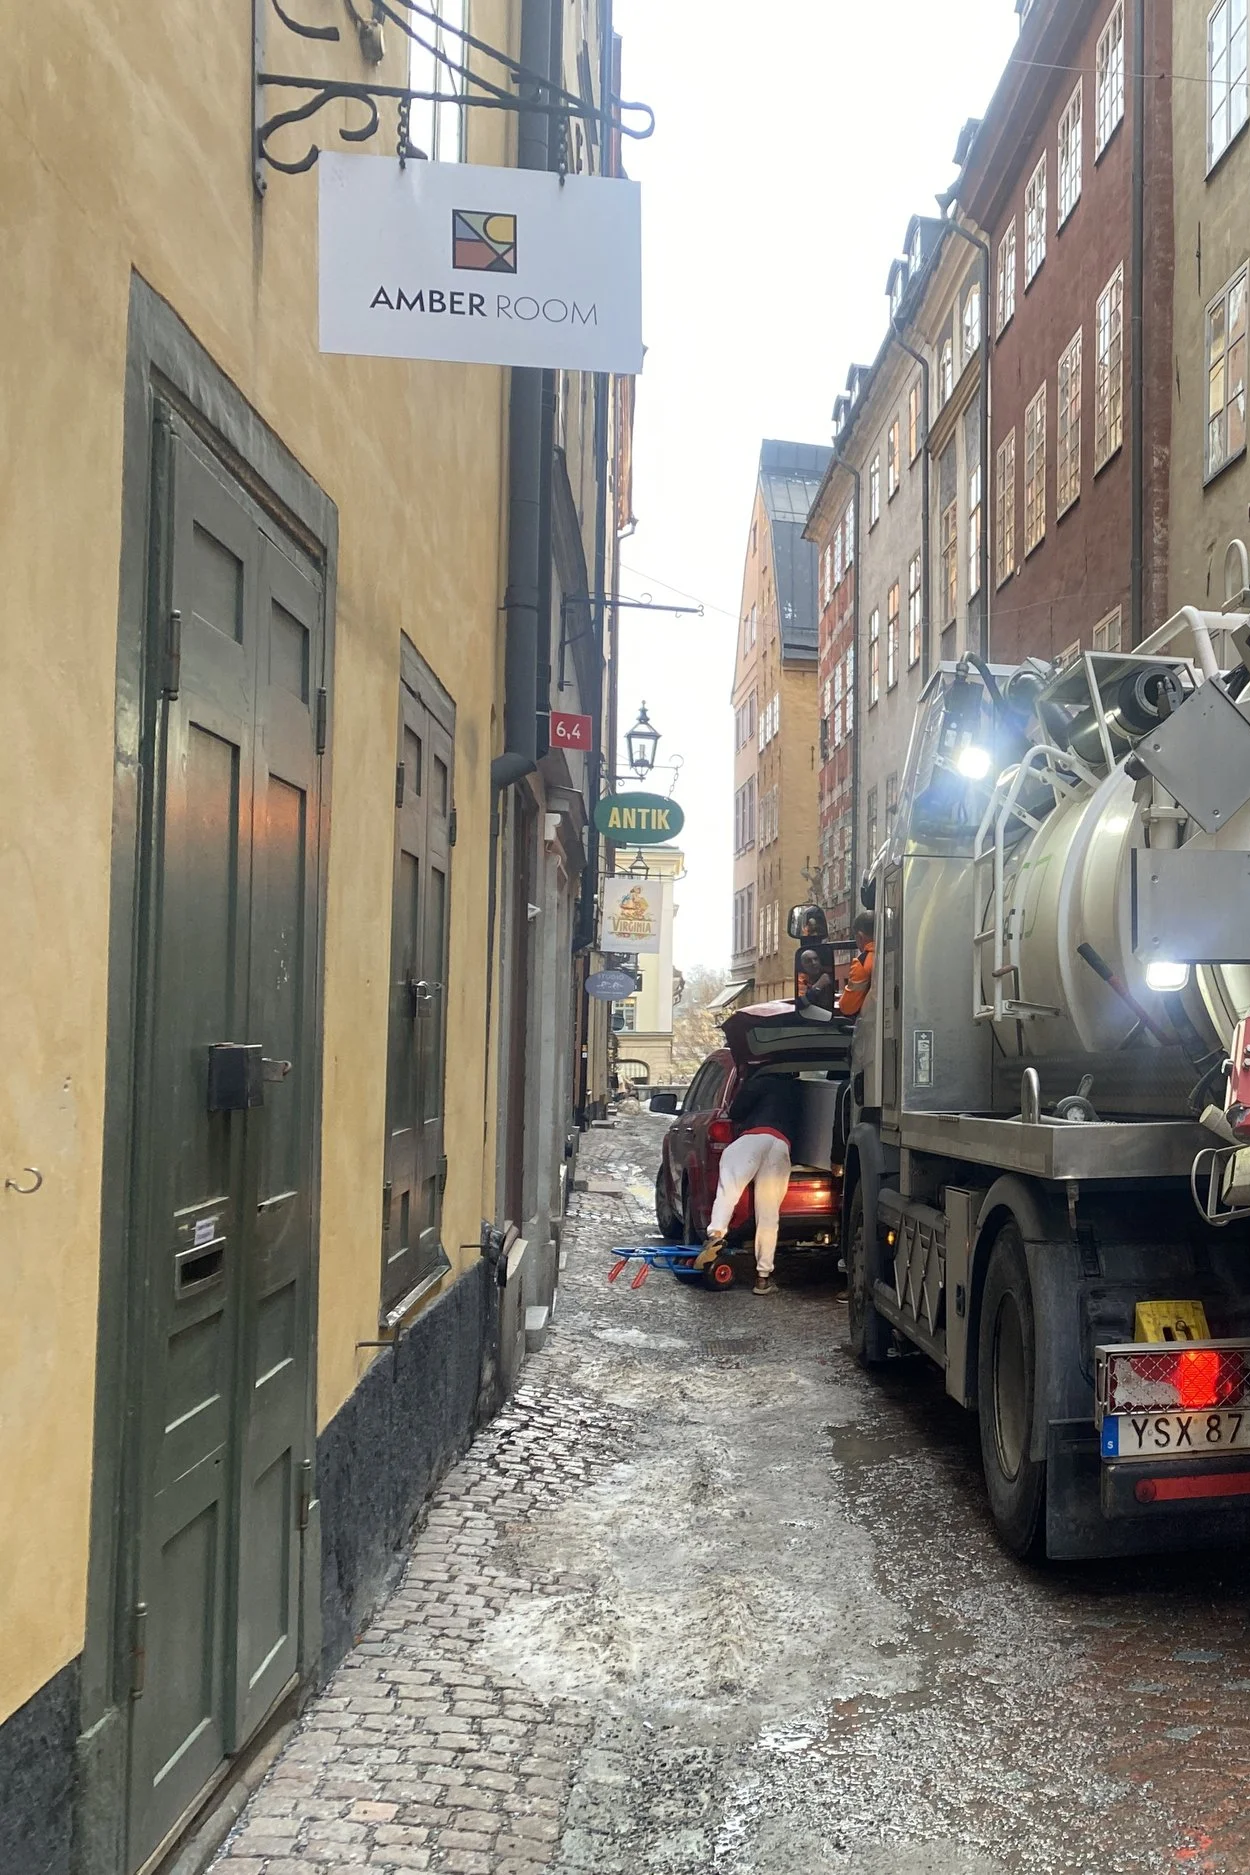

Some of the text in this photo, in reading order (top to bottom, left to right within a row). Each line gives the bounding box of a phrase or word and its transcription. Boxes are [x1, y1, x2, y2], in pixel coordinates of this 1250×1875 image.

[369, 285, 598, 326] AMBER ROOM
[556, 721, 581, 740] 6,4
[608, 806, 671, 830] ANTIK
[612, 916, 652, 934] VIRGINIA
[1131, 1416, 1193, 1449] YSX
[1107, 1440, 1114, 1449] S
